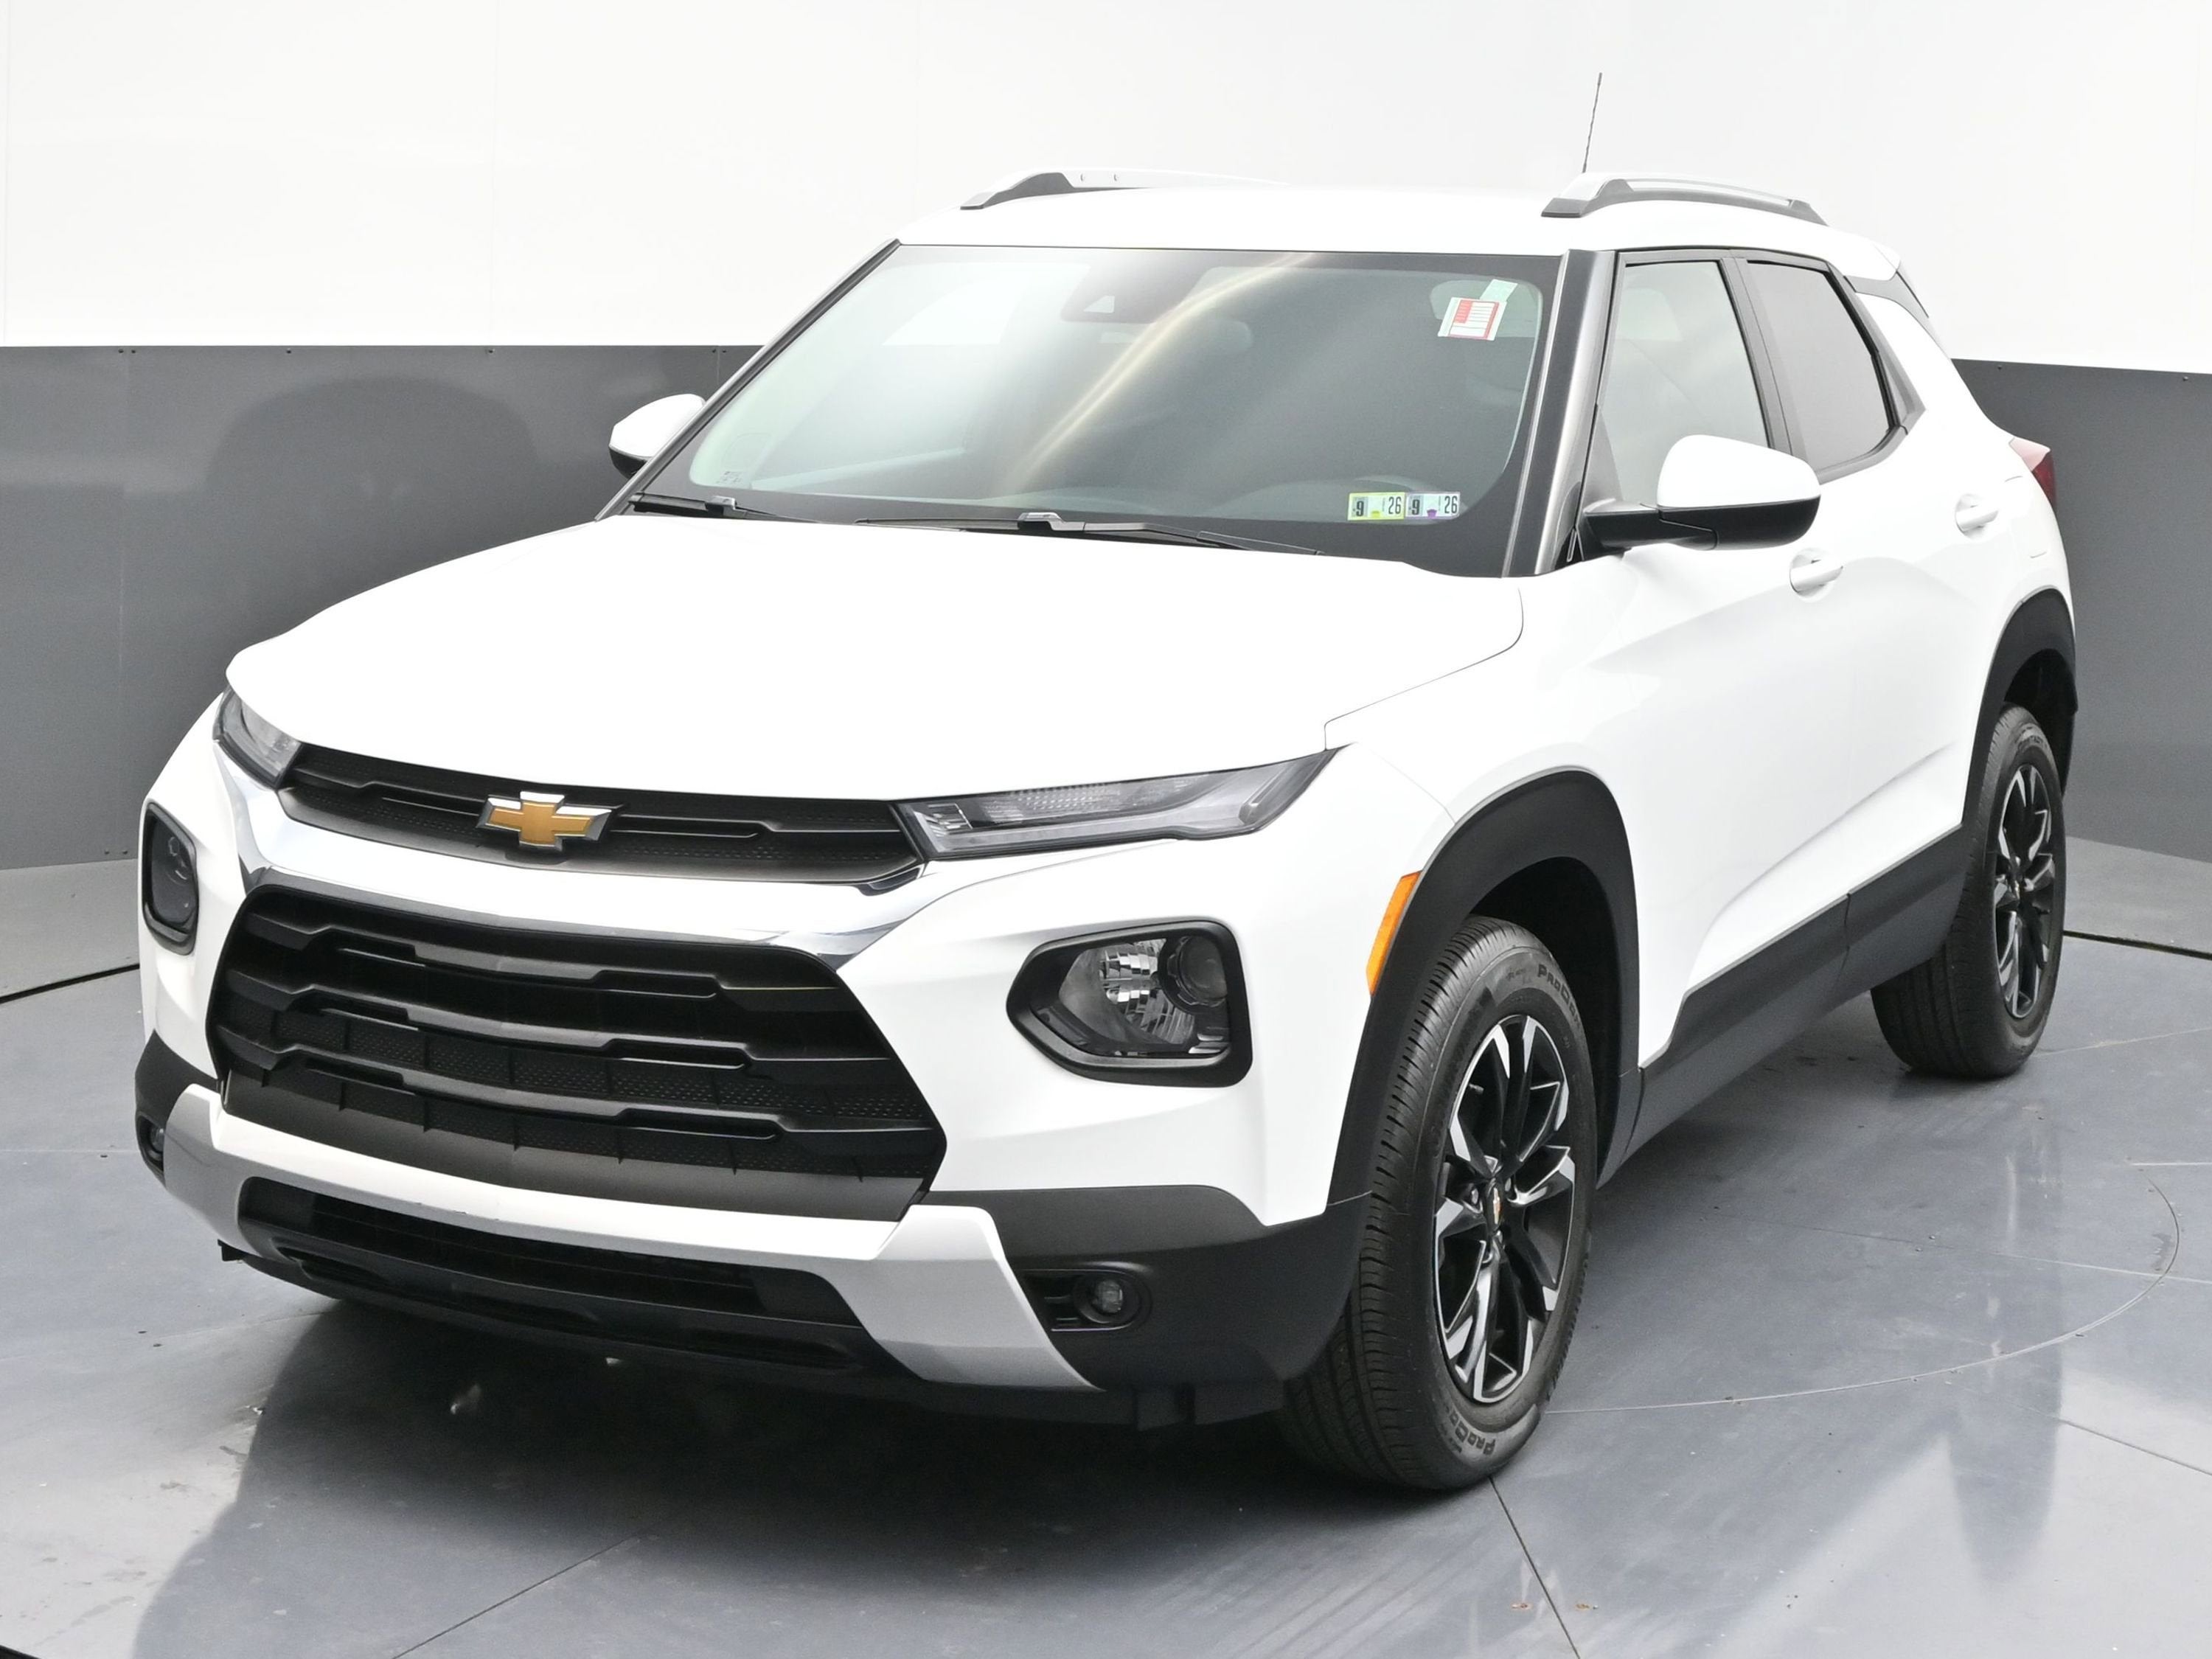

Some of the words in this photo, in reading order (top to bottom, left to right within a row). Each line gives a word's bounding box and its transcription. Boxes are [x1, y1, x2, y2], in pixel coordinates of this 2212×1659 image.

[1355, 501, 1364, 517] 9
[1388, 495, 1402, 515] 26
[1411, 498, 1420, 515] 9
[1444, 495, 1458, 514] 26
